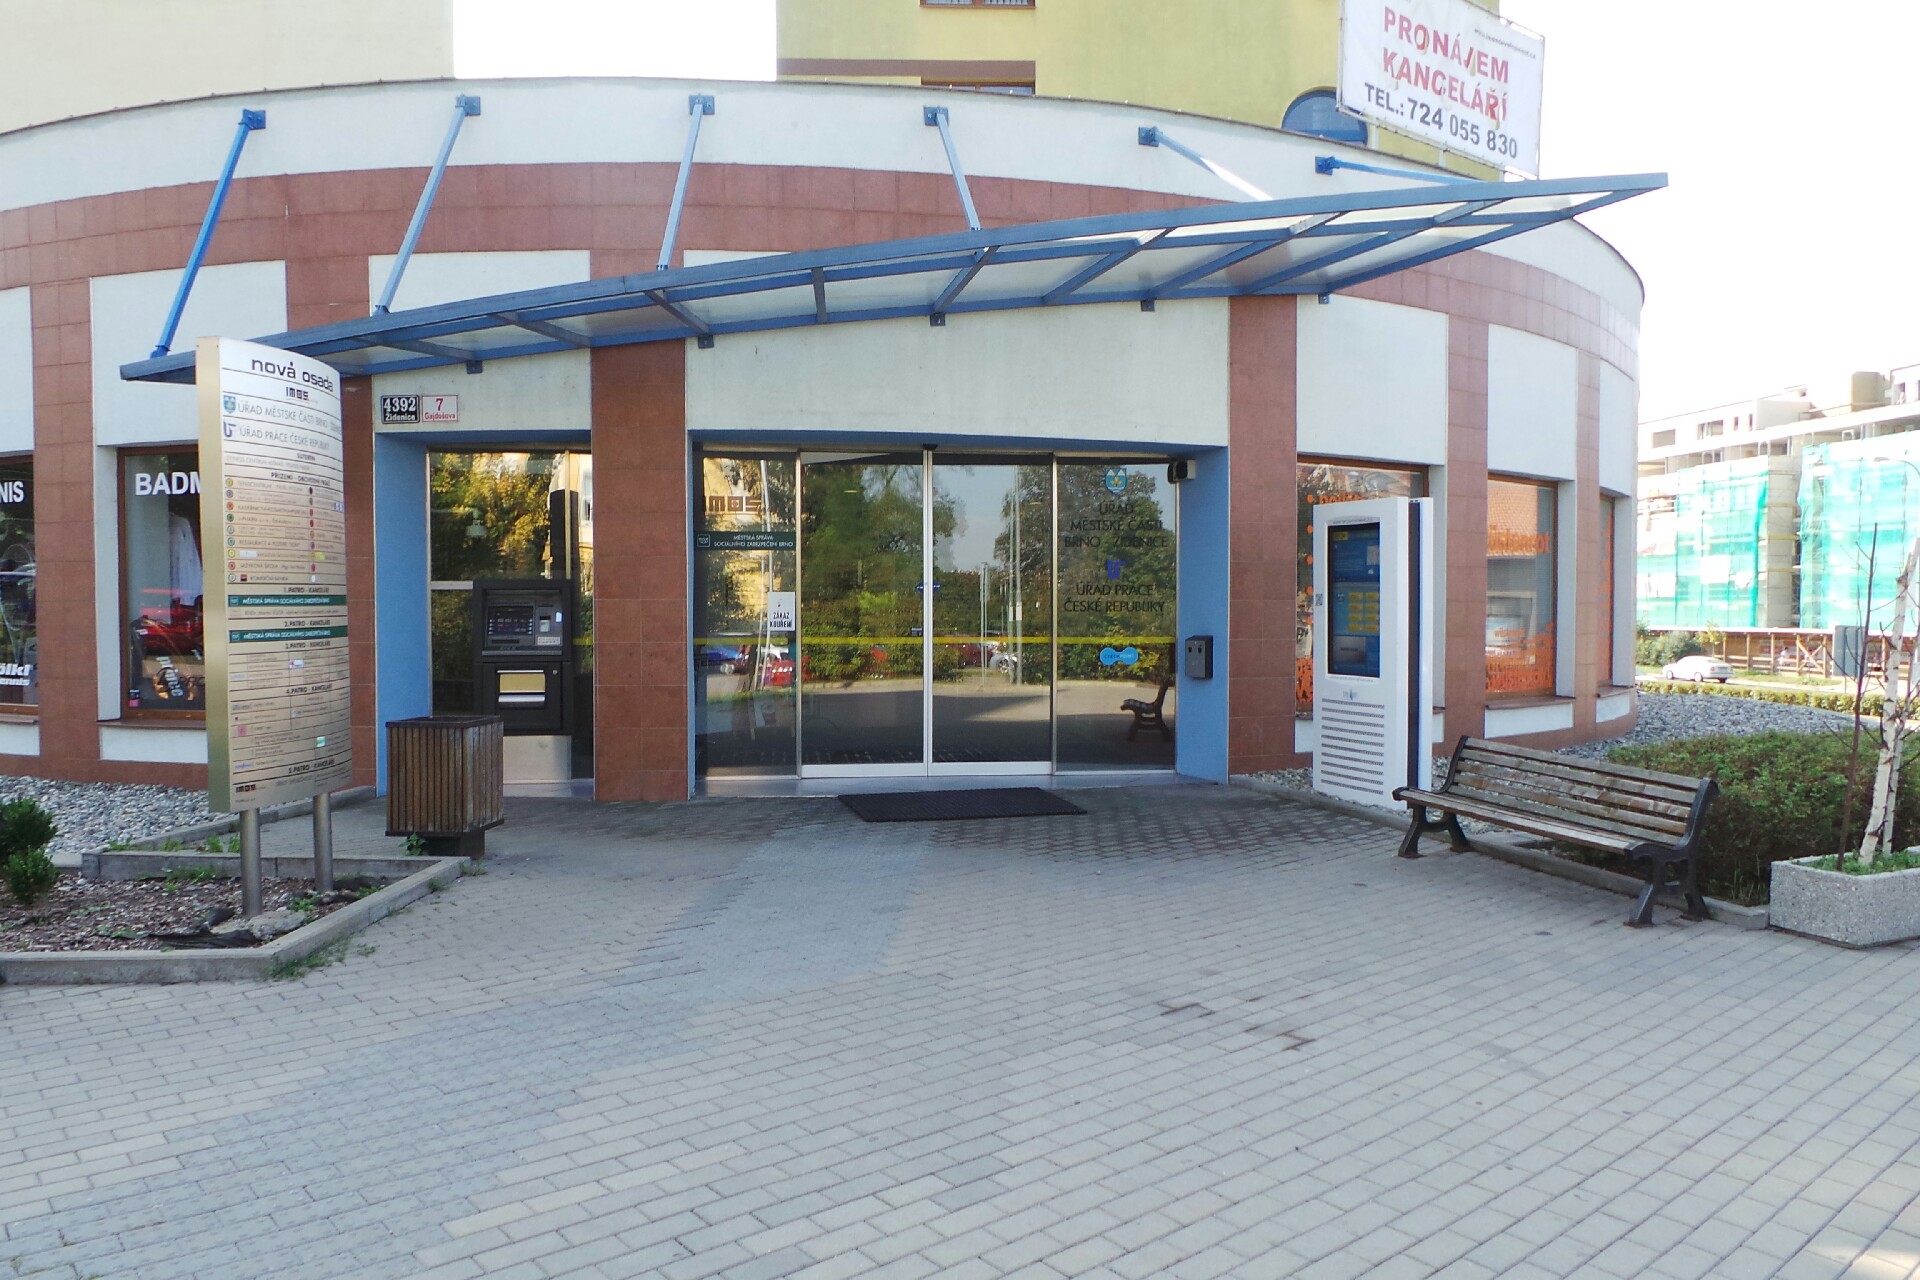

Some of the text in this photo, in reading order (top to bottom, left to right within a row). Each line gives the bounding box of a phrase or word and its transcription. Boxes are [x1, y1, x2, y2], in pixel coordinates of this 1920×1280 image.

[1384, 6, 1509, 84] PRONÁJEM
[1383, 47, 1508, 121] KANCELÁŘÍ
[1364, 82, 1517, 159] TEL.: 724 055 830
[251, 359, 334, 392] nová osada
[384, 397, 417, 412] 4392
[435, 398, 444, 411] 7
